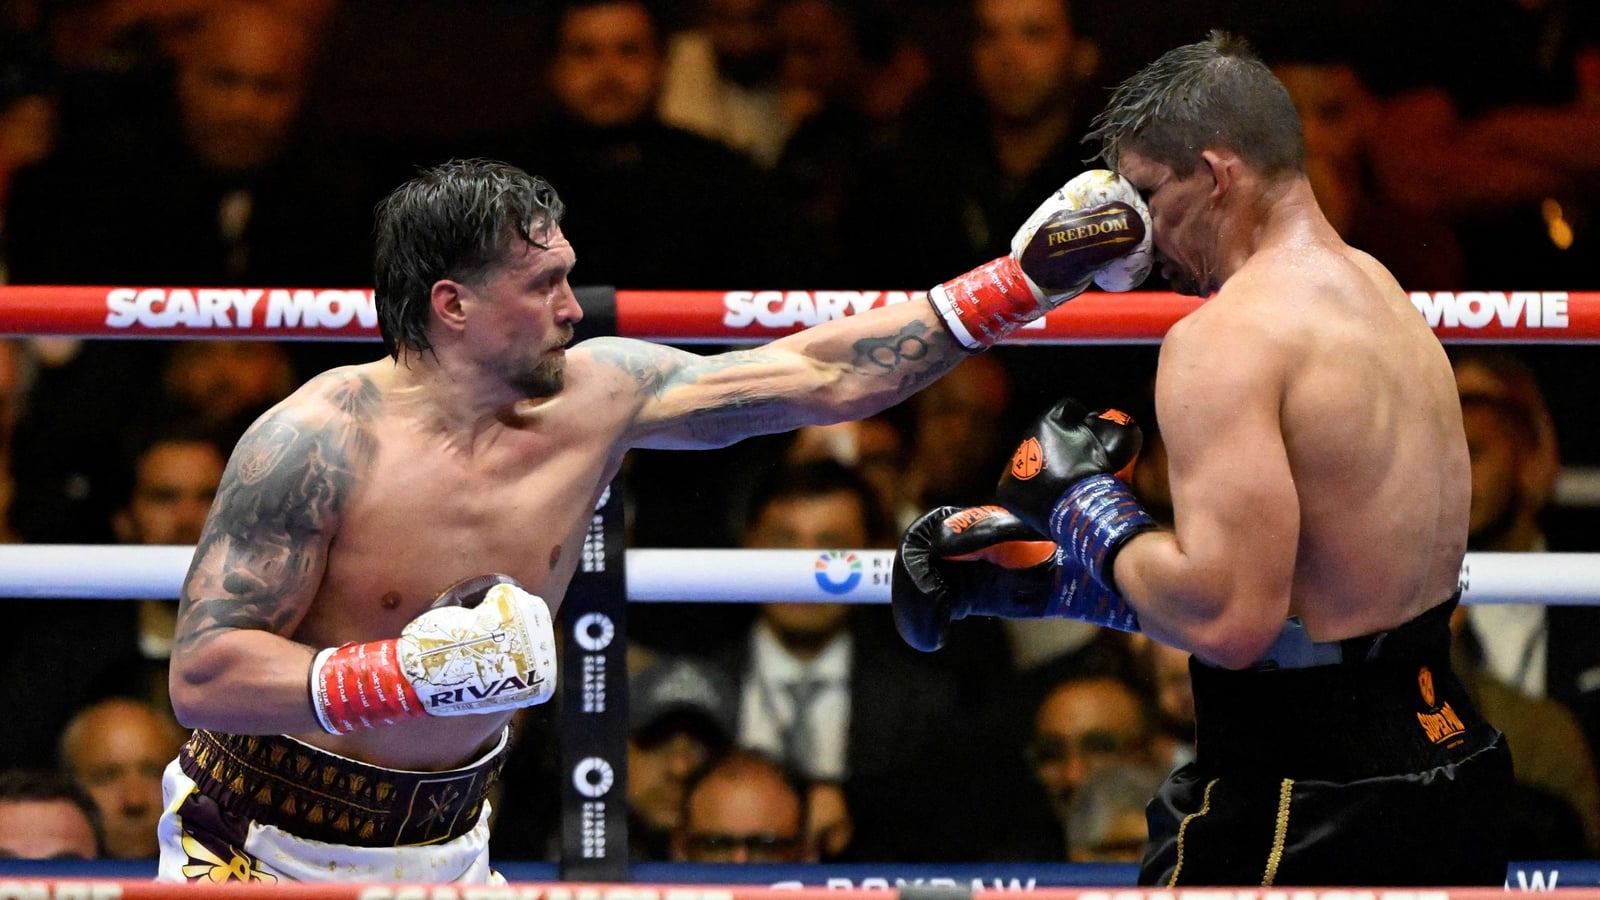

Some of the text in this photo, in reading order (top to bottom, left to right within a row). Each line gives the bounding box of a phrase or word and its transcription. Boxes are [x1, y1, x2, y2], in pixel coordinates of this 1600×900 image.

[1048, 218, 1129, 246] FREEDOM
[105, 288, 378, 328] SCARY MOV
[723, 291, 881, 328] SCARY
[1410, 291, 1569, 328] MOVIE
[583, 524, 595, 572] ASON
[592, 515, 606, 572] RIYADH
[430, 670, 545, 708] RIVAL
[583, 654, 595, 712] SEASON
[595, 654, 606, 712] RIYADH
[583, 802, 595, 858] SEASON
[595, 802, 606, 858] RIYADH
